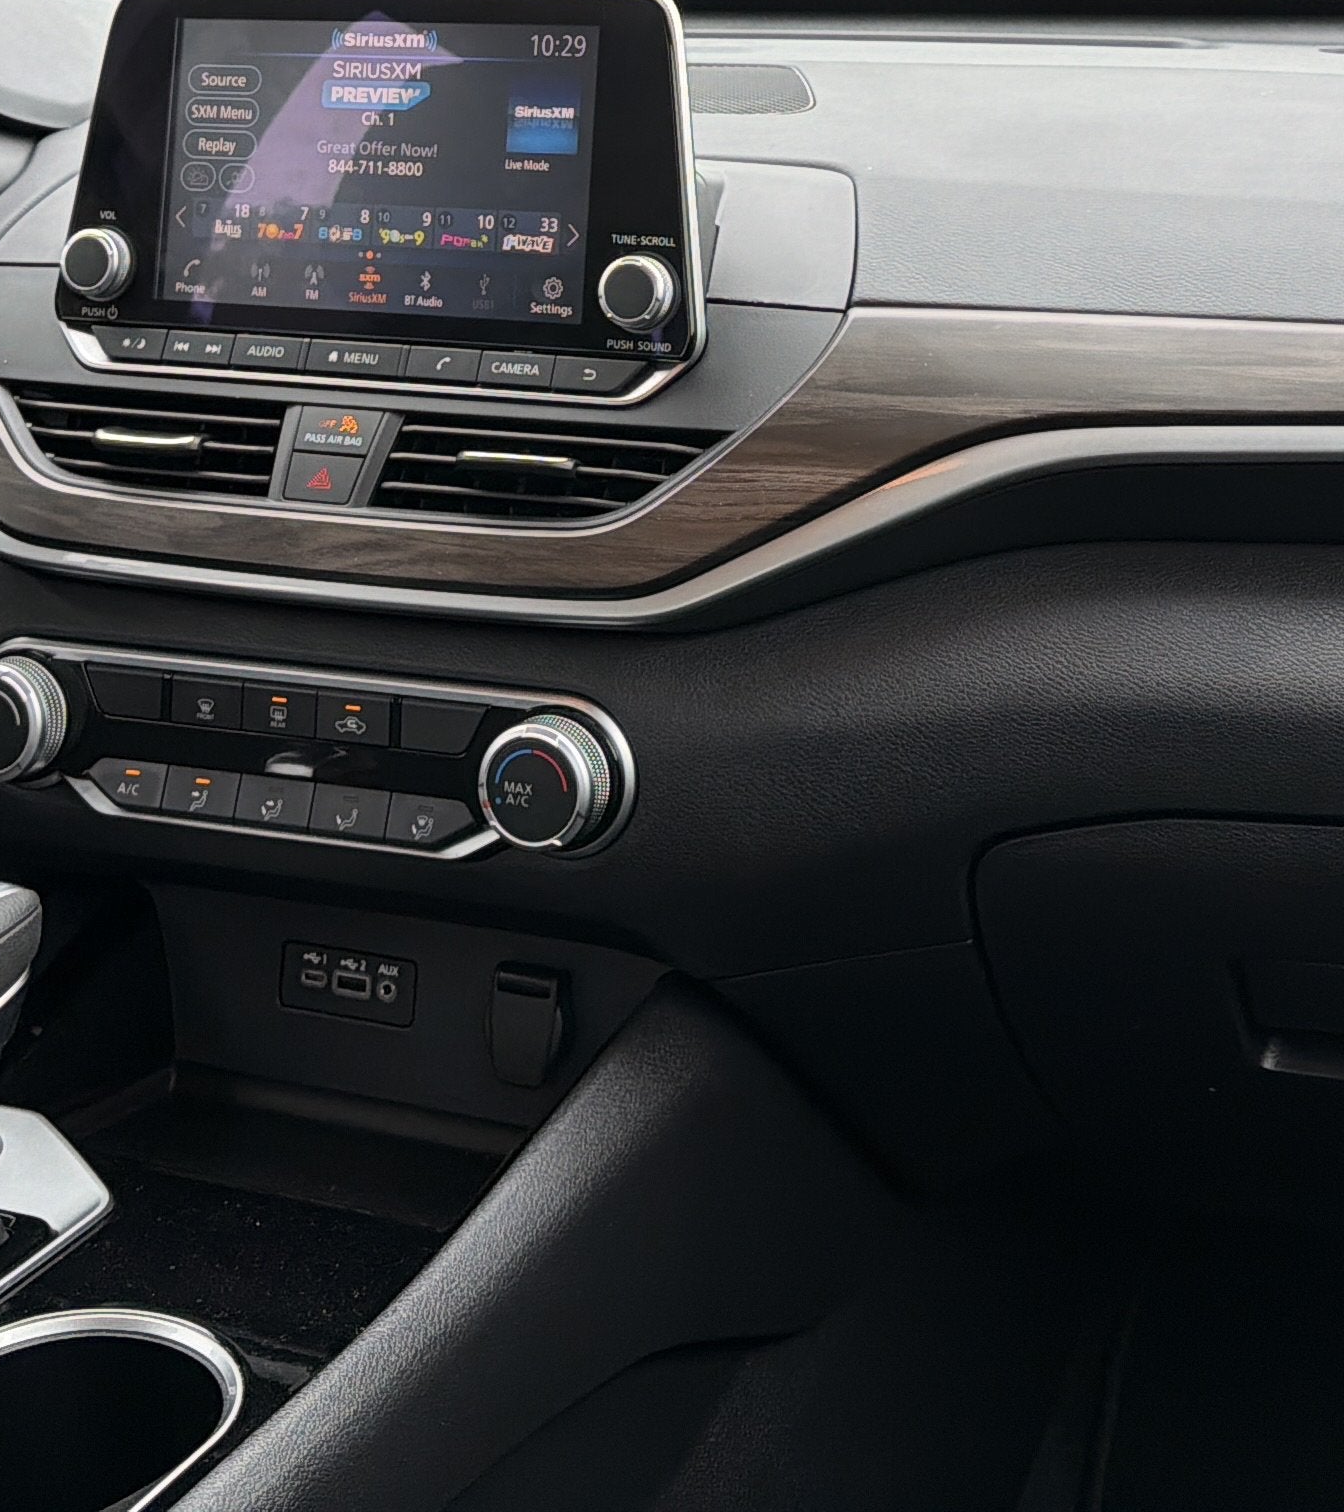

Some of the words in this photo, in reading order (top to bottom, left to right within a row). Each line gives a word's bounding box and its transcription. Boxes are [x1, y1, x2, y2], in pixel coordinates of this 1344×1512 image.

[530, 35, 586, 57] 10:29
[333, 60, 421, 79] SIRIUSXM
[201, 73, 246, 88] Source
[331, 87, 420, 104] PREVIEW
[191, 104, 217, 118] SXM
[220, 106, 252, 120] Menu
[361, 112, 384, 126] Ch.
[388, 112, 394, 126] 1
[514, 105, 575, 119] SiriusXM
[198, 138, 236, 155] Replay
[317, 141, 355, 154] Great
[359, 142, 396, 156] Offer
[401, 143, 438, 157] Now!
[328, 159, 423, 177] 844-711-8800
[505, 159, 522, 170] Live
[524, 159, 549, 171] Mode
[100, 211, 117, 220] VOL
[200, 204, 207, 214] 7
[235, 204, 250, 218] 18
[259, 207, 266, 217] 8
[301, 207, 309, 220] 7
[319, 210, 326, 220] 9
[360, 210, 370, 224] 8
[378, 212, 390, 223] 10
[422, 212, 432, 227] 9
[440, 215, 451, 225] 11
[478, 215, 495, 230] 10
[503, 218, 515, 228] 12
[540, 218, 558, 233] 33
[176, 282, 205, 294] Phone
[251, 286, 266, 297] AM
[306, 289, 319, 300] FM
[348, 292, 387, 304] SiriusXM
[404, 295, 415, 306] BT
[417, 295, 443, 308] Audio
[82, 307, 105, 317] PUSH
[530, 302, 573, 318] Settings
[247, 346, 284, 358] AUDIO
[607, 339, 633, 351] PUSH
[638, 341, 672, 353] SOUND
[344, 352, 379, 366] MENU
[491, 362, 540, 377] CAMERA
[304, 433, 326, 444] PASS
[327, 435, 343, 445] AIR
[344, 436, 363, 446] BAG
[117, 782, 140, 796] A/C
[504, 781, 533, 796] MAX
[506, 793, 529, 807] A/C
[360, 960, 366, 971] 2
[378, 963, 399, 977] AUX
